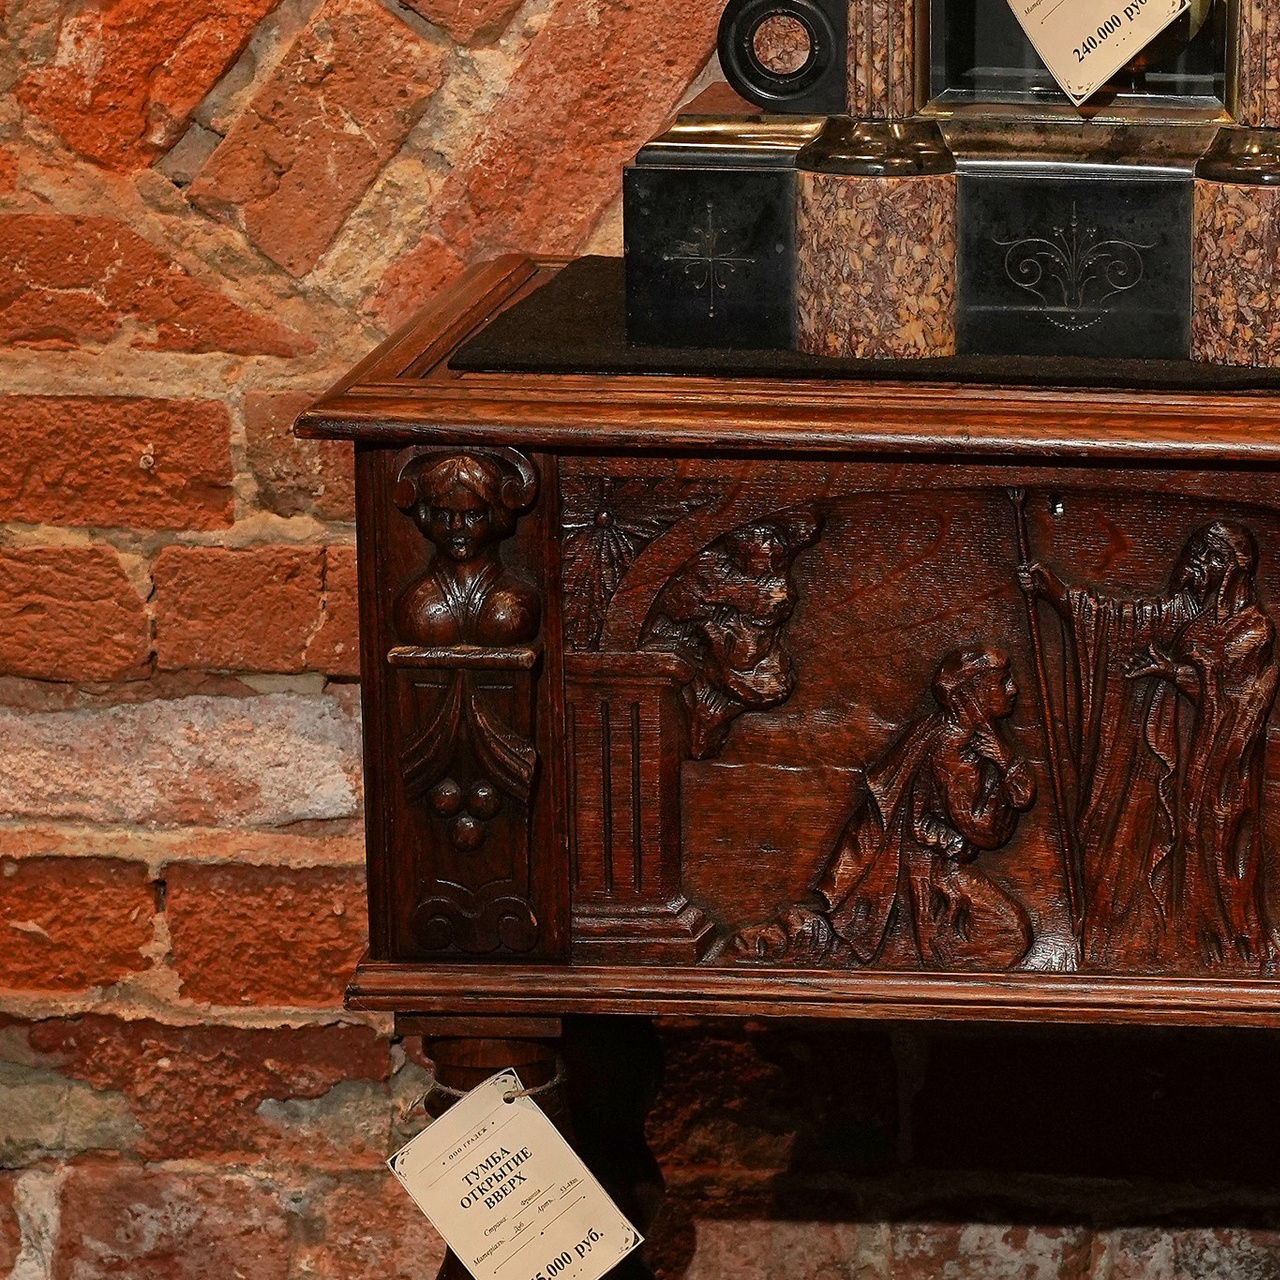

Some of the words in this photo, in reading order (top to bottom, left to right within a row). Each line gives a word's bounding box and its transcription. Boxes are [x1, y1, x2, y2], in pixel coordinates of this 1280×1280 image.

[1073, 14, 1121, 63] 240.000
[460, 1146, 533, 1209] ОТКРЫТИЕ
[462, 1147, 511, 1187] ТУМБА
[484, 1171, 527, 1210] ВВЕРХ
[573, 1228, 604, 1259] руб.
